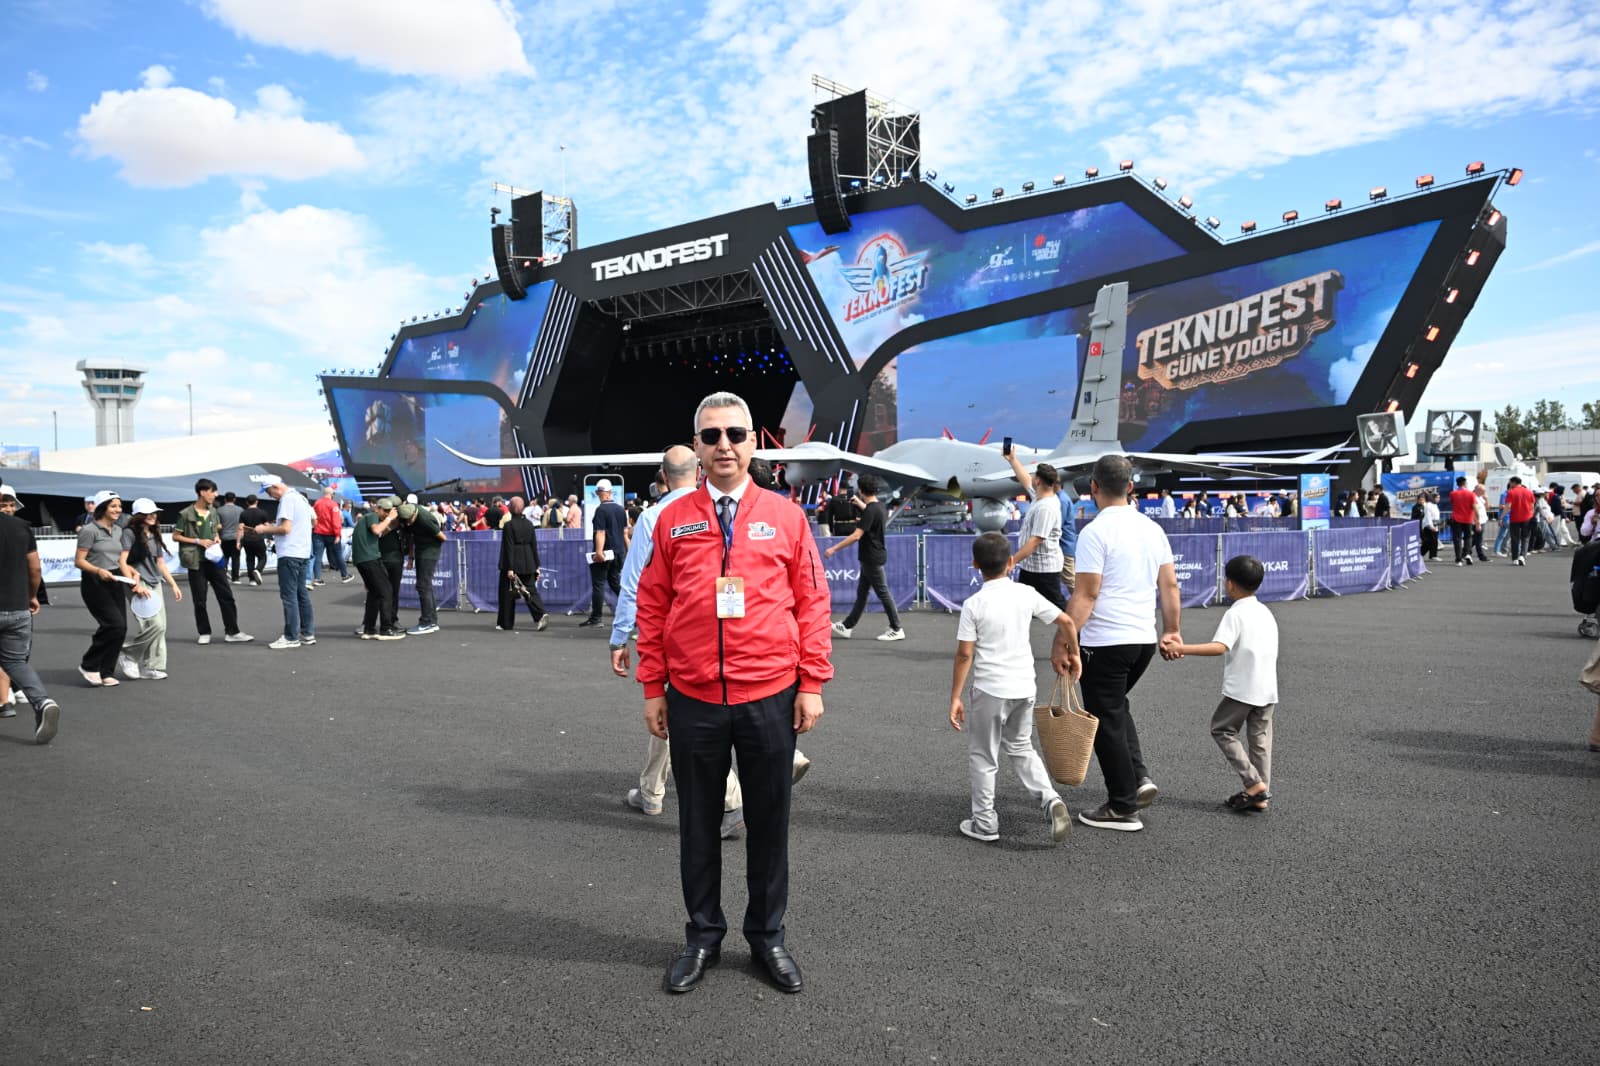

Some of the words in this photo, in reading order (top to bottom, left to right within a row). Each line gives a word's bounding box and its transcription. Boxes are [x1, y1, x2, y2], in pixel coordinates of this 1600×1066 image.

[591, 233, 729, 281] TEKNOFEST
[843, 265, 929, 322] TEKNOFEST
[1138, 271, 1333, 364] TEKNOFEST
[1166, 324, 1298, 380] GÜNEYDOĞU
[1174, 562, 1202, 570] RIGINAL
[1262, 560, 1289, 572] YKAR
